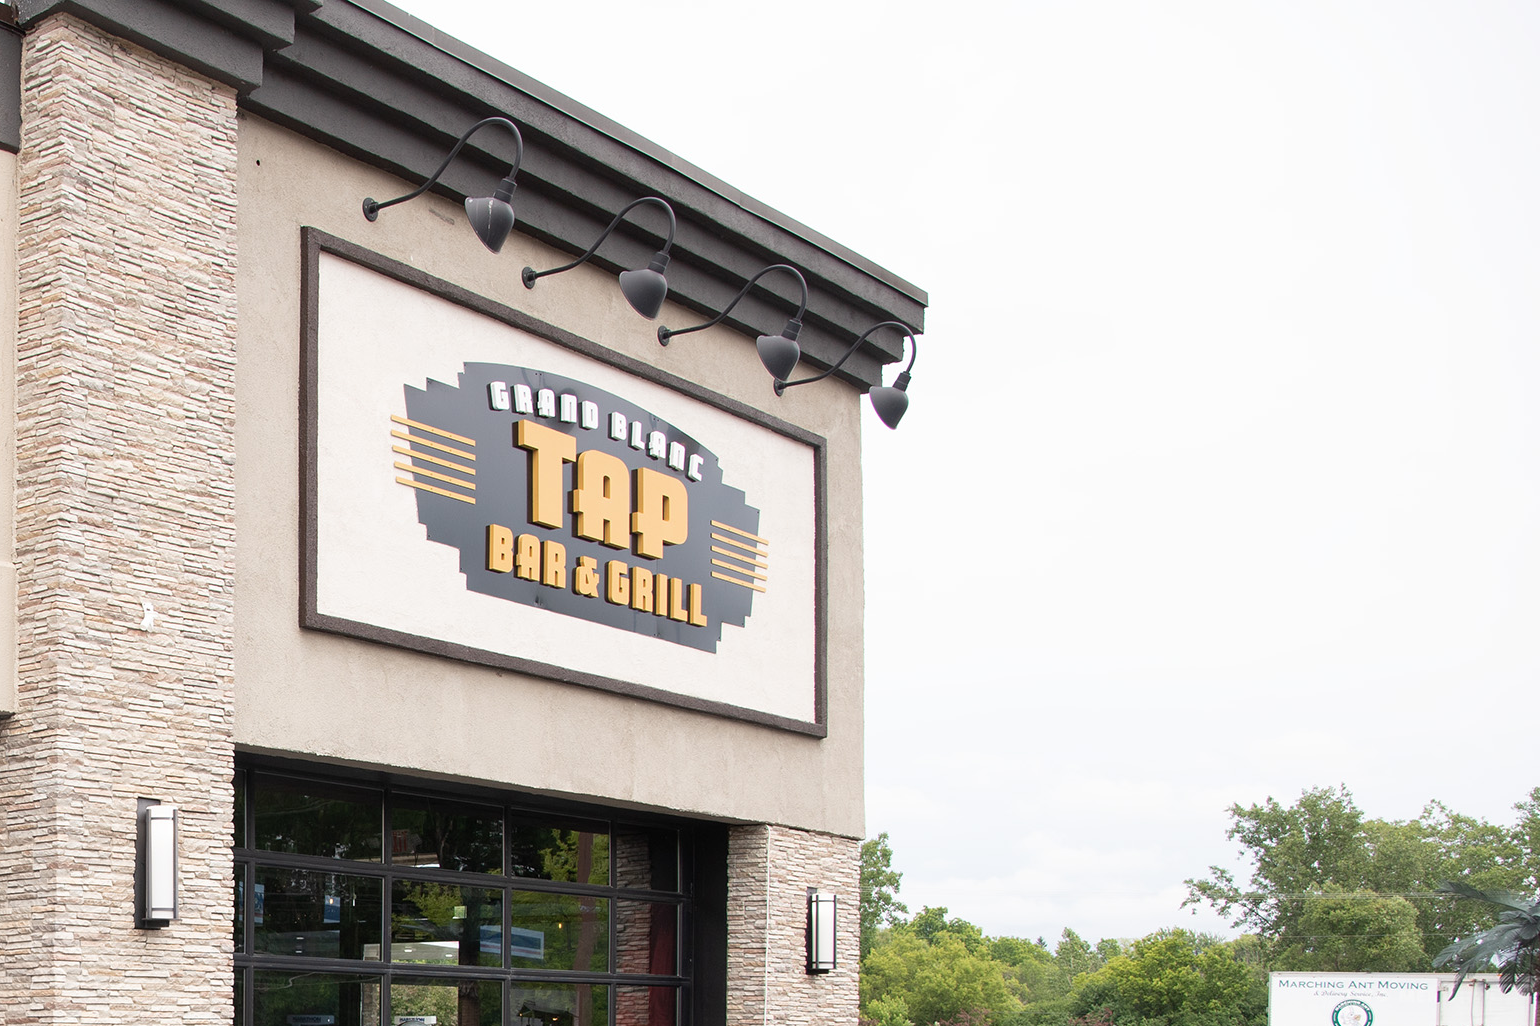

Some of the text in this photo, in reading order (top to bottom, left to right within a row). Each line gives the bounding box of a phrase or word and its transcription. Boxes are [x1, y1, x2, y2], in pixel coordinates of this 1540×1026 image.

[488, 380, 704, 483] GRAND BLANC
[512, 418, 688, 560] TAP
[486, 523, 708, 628] BAR & GRILL
[1278, 979, 1428, 990] MARCHING ANT MOVING
